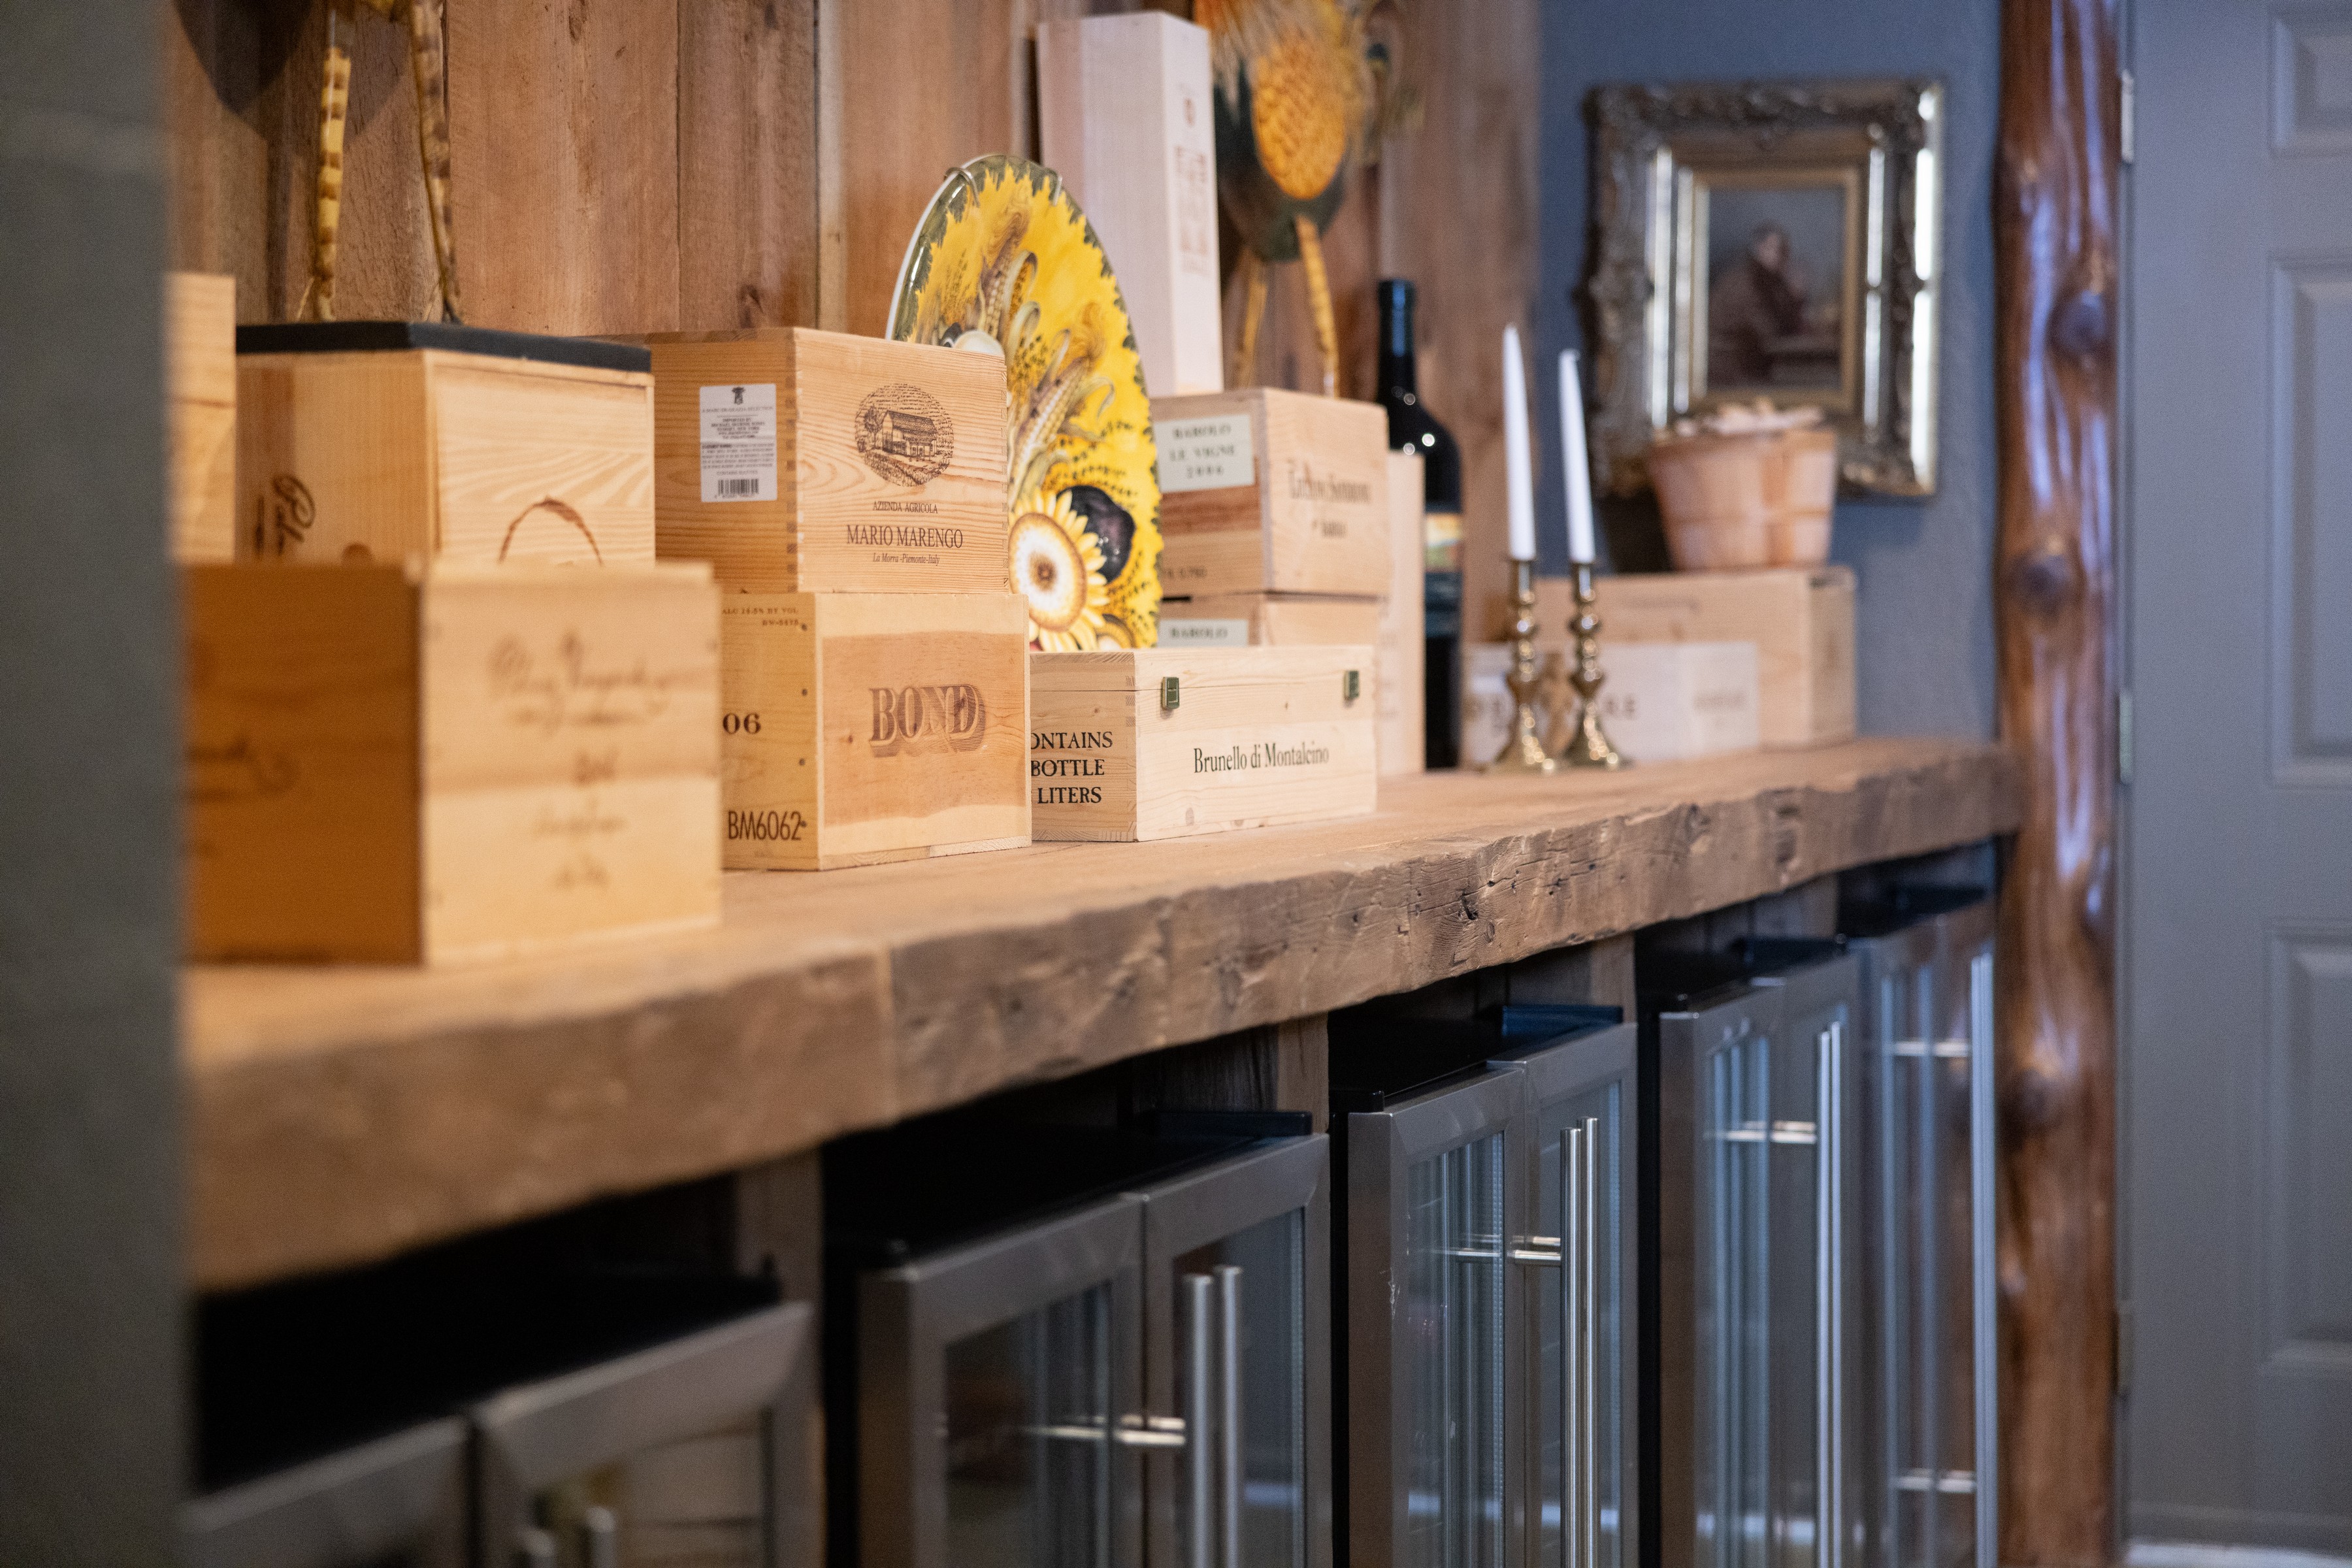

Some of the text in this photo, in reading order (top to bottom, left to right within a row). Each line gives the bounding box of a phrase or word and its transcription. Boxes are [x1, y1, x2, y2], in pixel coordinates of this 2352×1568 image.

[1173, 424, 1232, 439] BAROLO
[873, 501, 938, 514] AZIENDA AGRICOLA
[847, 525, 963, 548] MARIO MARENGO
[873, 553, 880, 562] La
[882, 553, 898, 563] Morra
[723, 713, 761, 735] 06
[868, 684, 986, 757] BOND
[1031, 731, 1113, 749] ONTAINS
[1194, 741, 1329, 773] Brunello di Montalcino
[1031, 759, 1105, 776] BOTTLE
[1037, 787, 1102, 804] LITERS
[728, 810, 802, 840] BM6062
